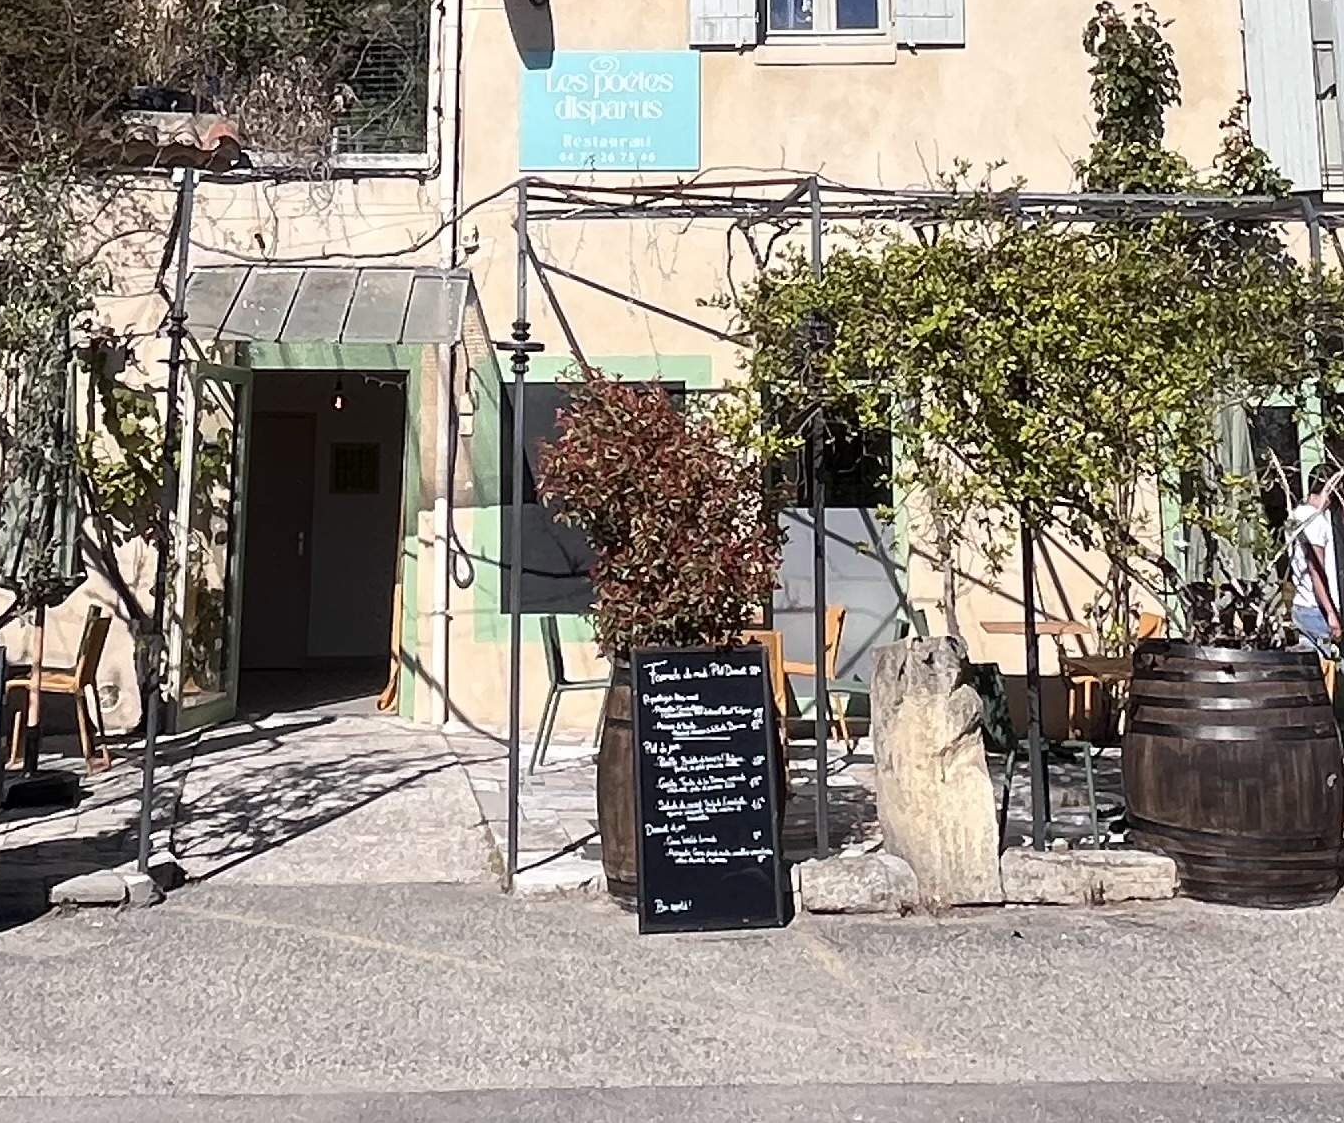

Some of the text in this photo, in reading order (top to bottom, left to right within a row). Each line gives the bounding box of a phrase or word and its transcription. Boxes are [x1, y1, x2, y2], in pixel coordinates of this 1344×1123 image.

[546, 71, 589, 93] Les
[554, 94, 664, 126] disparus
[562, 133, 652, 149] Restaurant
